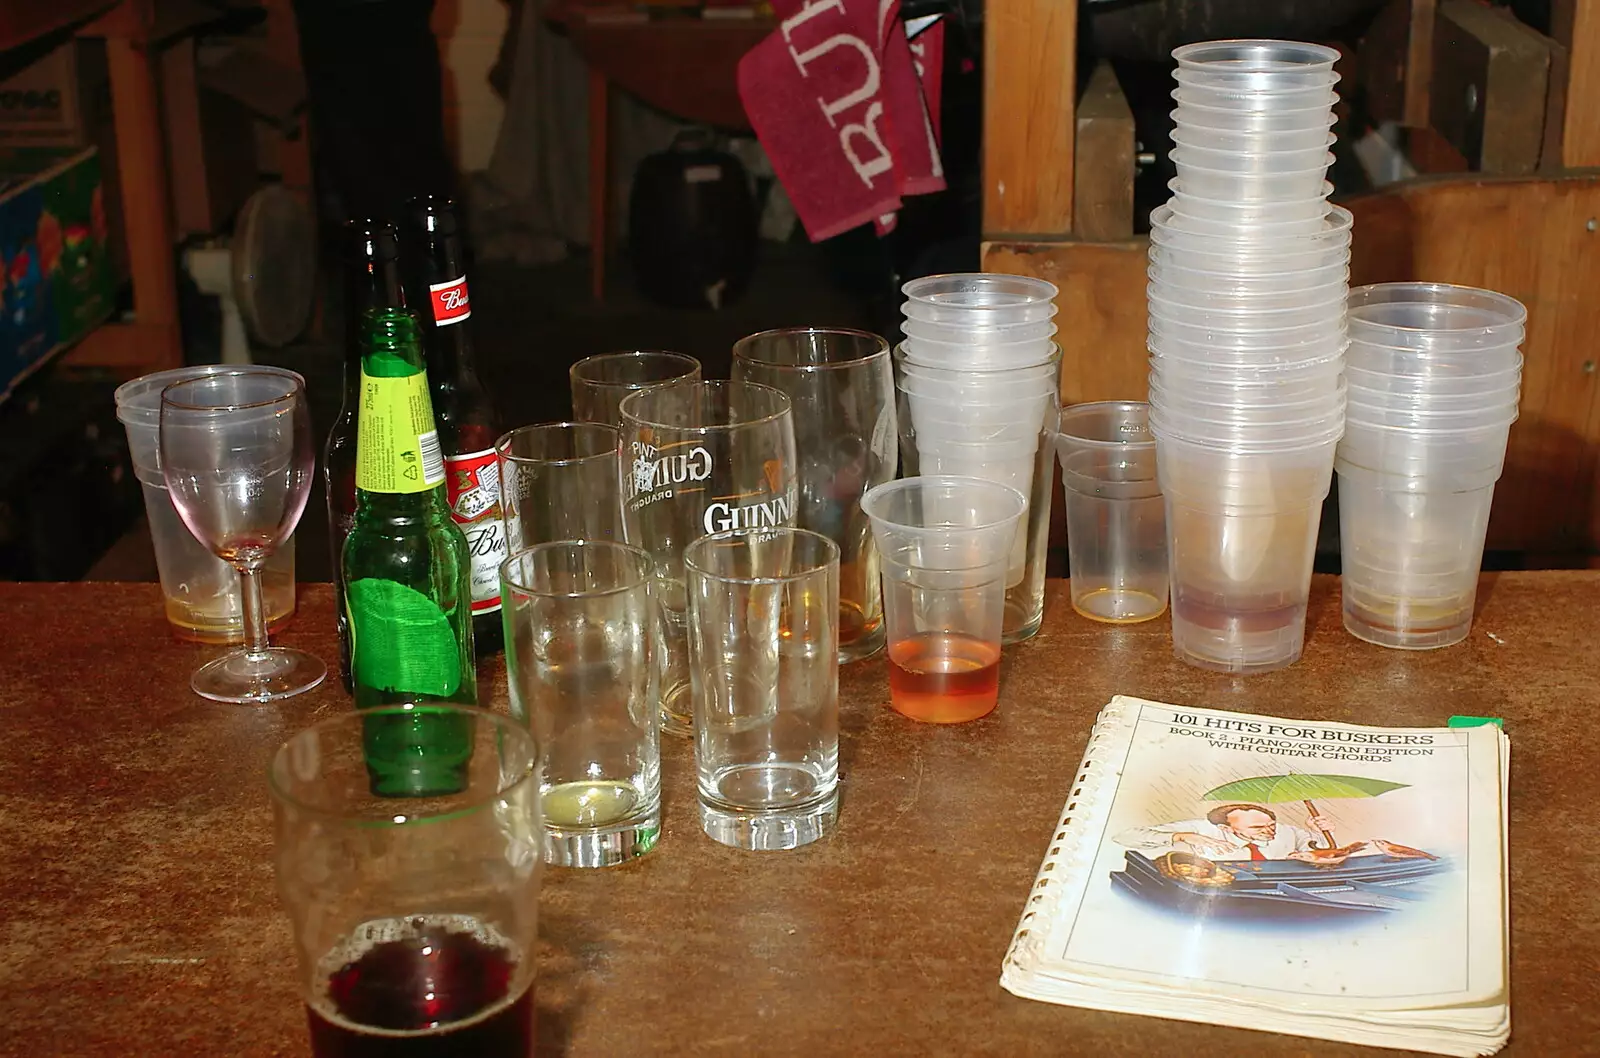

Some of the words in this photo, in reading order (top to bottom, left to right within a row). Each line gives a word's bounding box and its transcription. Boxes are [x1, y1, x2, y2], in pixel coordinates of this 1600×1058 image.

[632, 441, 658, 459] PINT
[1168, 727, 1215, 740] BOOK
[1218, 733, 1228, 741] 2
[1239, 735, 1360, 753] PIANO/ORGAN
[1364, 747, 1434, 756] EDITION
[1171, 713, 1198, 726] 101
[1203, 717, 1262, 733] HITS
[1266, 724, 1317, 740] FOR
[1320, 729, 1434, 745] BUSKERS
[1208, 740, 1253, 752] WITH
[1255, 746, 1318, 758] GUITAR
[1321, 752, 1392, 763] CHORDS
